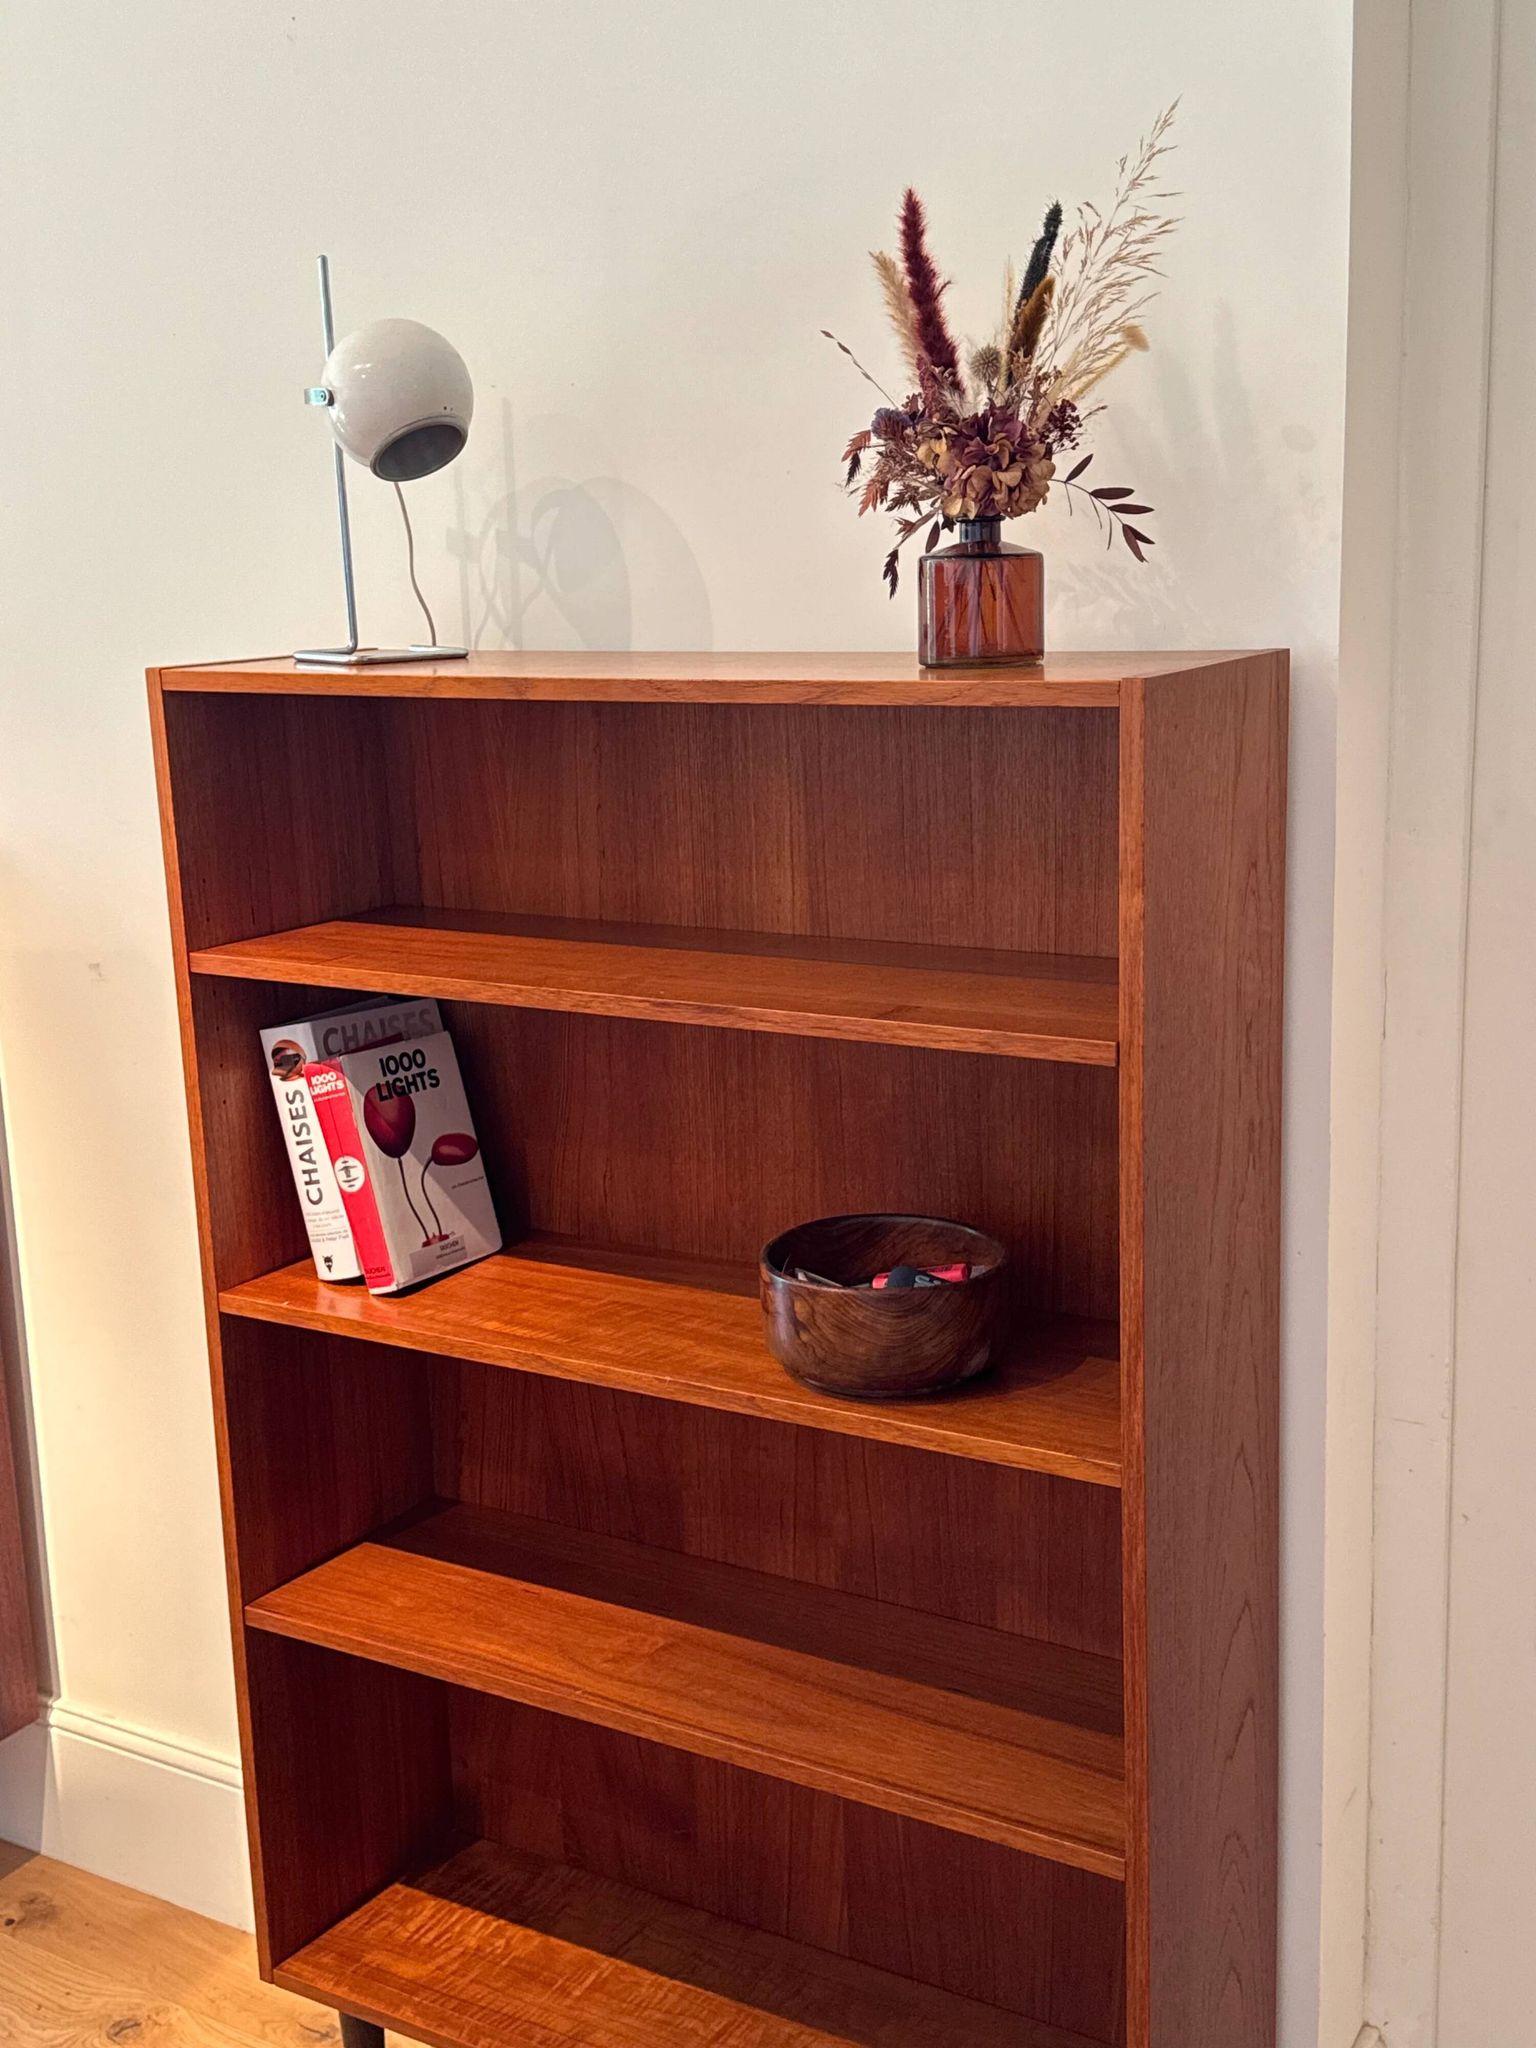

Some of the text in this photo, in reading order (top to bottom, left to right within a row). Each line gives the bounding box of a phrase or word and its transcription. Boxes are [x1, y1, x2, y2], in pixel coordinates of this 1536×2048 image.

[323, 1008, 435, 1057] CHAISES
[310, 1071, 337, 1086] 1000
[379, 1048, 426, 1078] 1000
[310, 1079, 346, 1096] LIGHTS
[376, 1068, 441, 1102] LIGHTS
[286, 1089, 323, 1205] CHAISES
